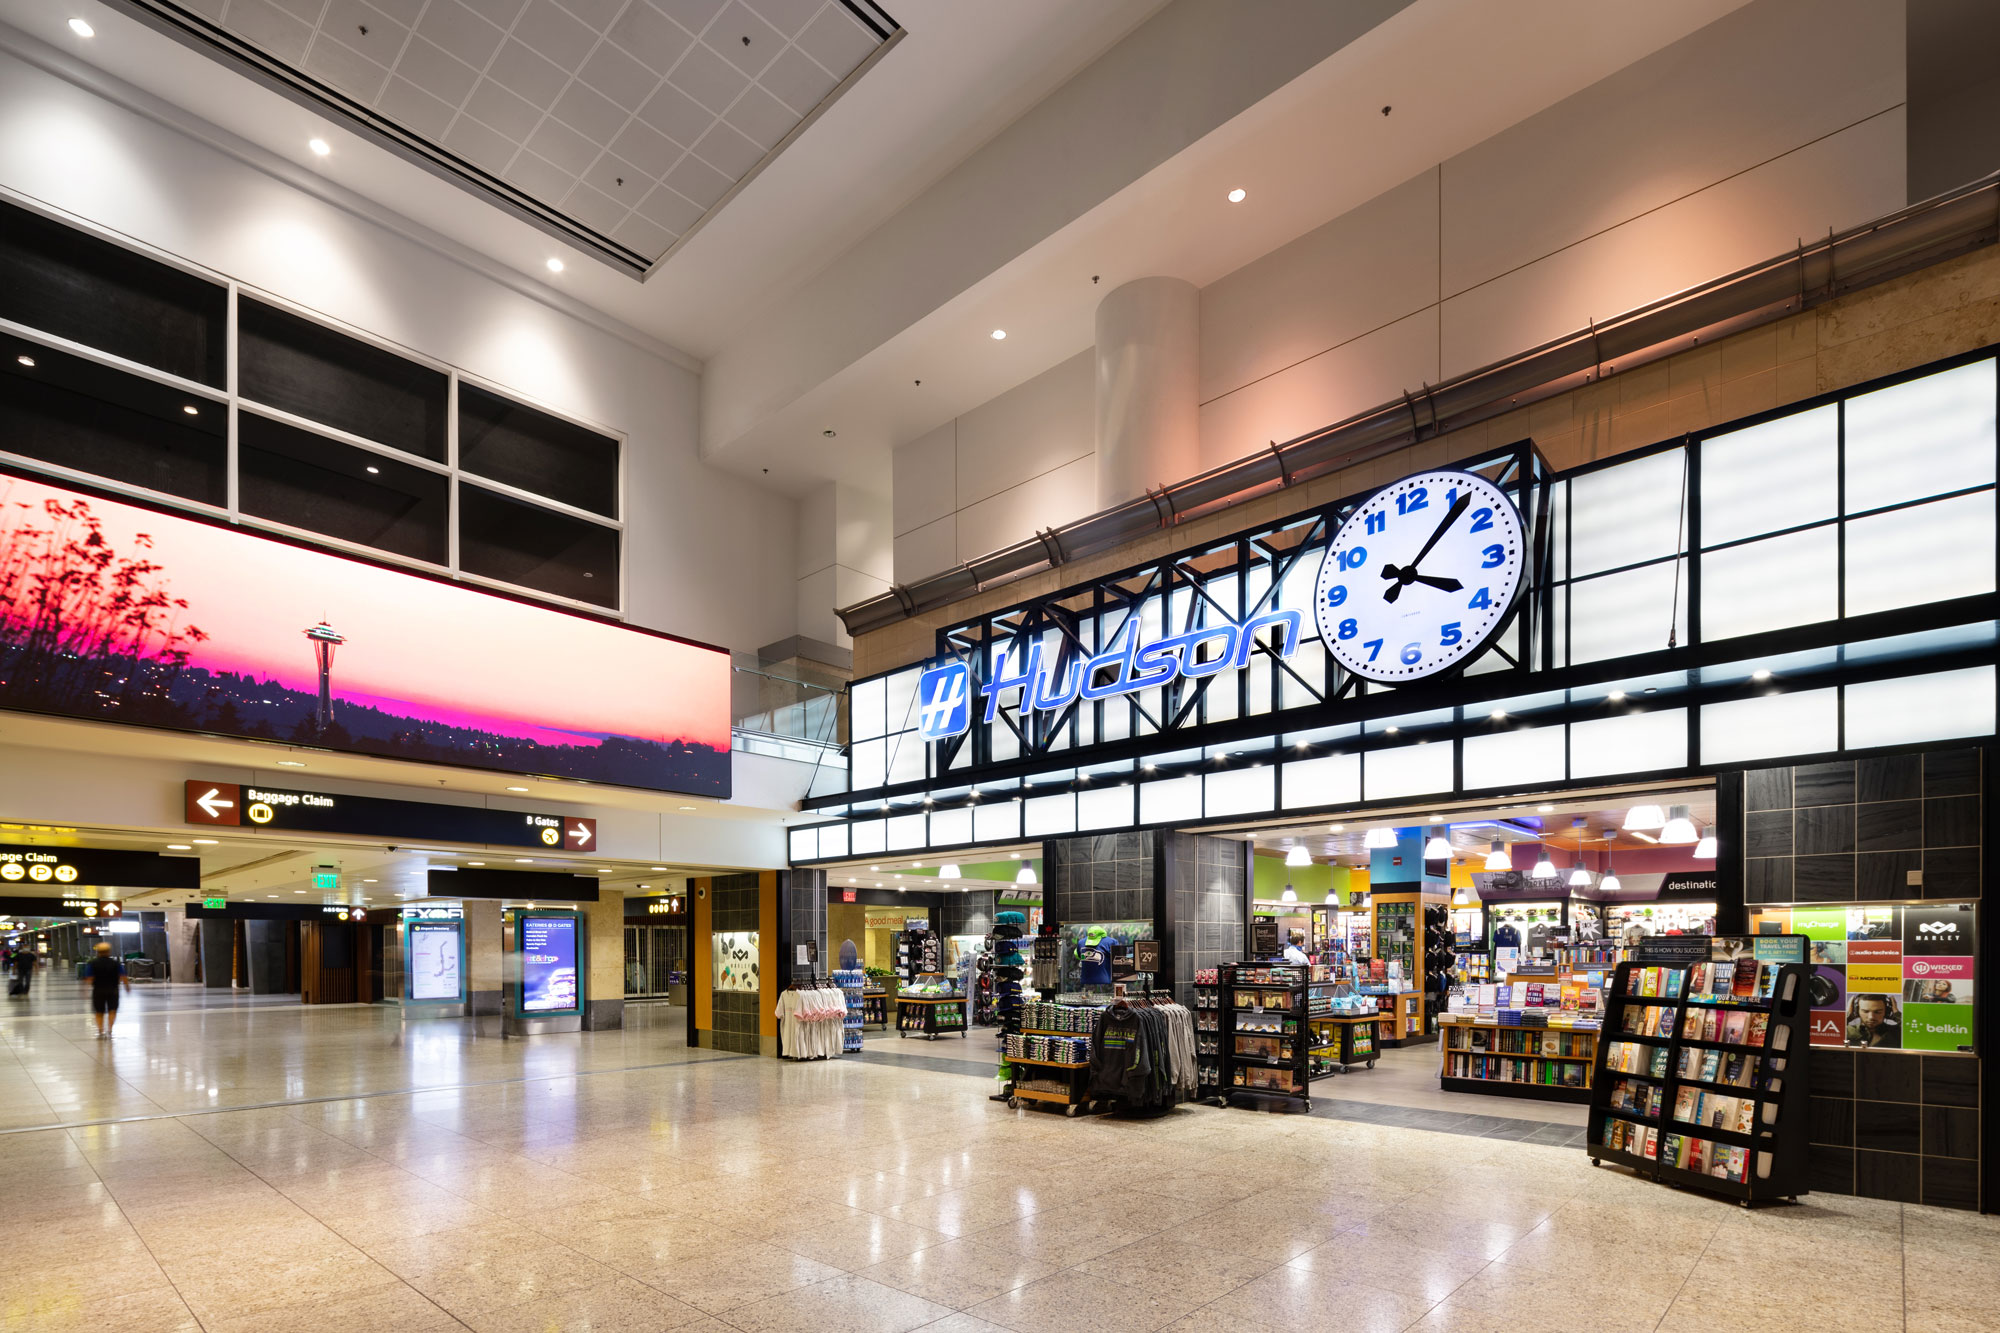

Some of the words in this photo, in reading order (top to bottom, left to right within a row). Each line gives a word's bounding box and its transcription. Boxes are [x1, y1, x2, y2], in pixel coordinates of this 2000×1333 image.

[1396, 487, 1429, 516] 12
[1445, 487, 1458, 511] 1
[1364, 510, 1386, 536] 11
[1469, 507, 1494, 534] 2
[1336, 546, 1368, 572] 10
[1481, 543, 1506, 569] 3
[1327, 584, 1348, 607] 9
[1468, 586, 1492, 611] 4
[1337, 618, 1358, 640] 8
[1440, 621, 1463, 647] 5
[1363, 638, 1383, 662] 7
[1400, 642, 1422, 665] 6
[980, 607, 1306, 725] Hudson
[248, 789, 299, 806] Baggage
[302, 794, 334, 807] Claim
[526, 815, 533, 825] B
[535, 816, 559, 827] Gates
[0, 853, 23, 863] age
[25, 852, 58, 863] Claim
[317, 873, 338, 888] EXIT
[207, 898, 225, 909] EXIT
[865, 915, 869, 924] A
[870, 915, 886, 927] good
[1926, 1023, 1968, 1034] belkin
